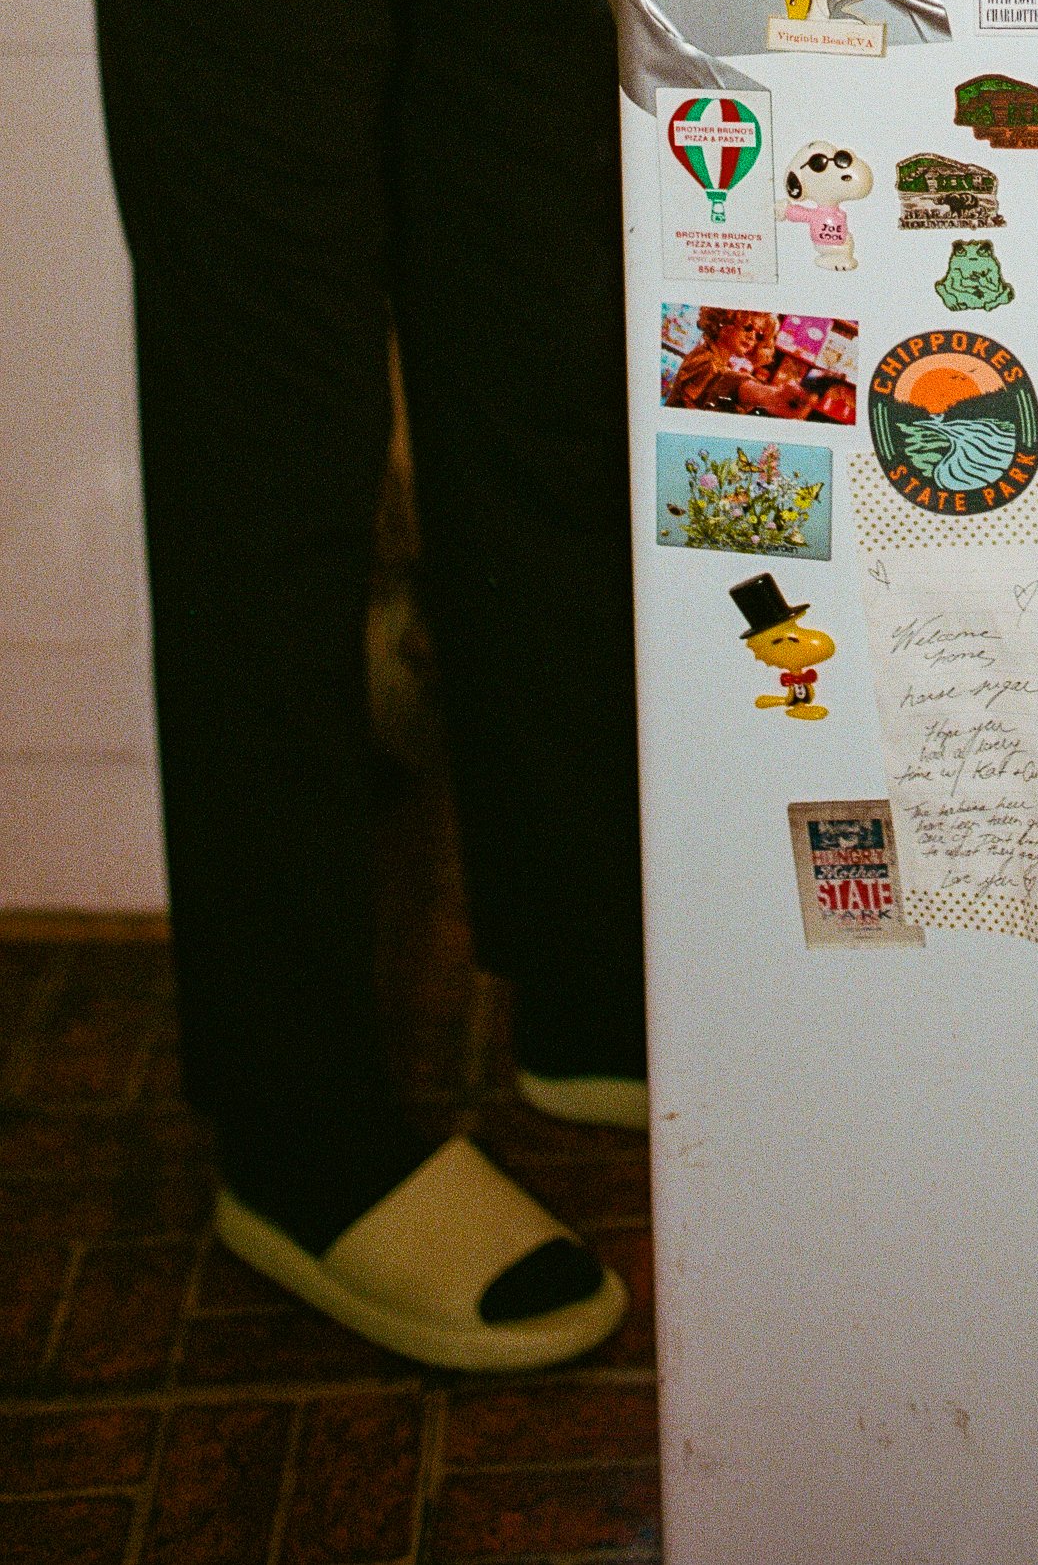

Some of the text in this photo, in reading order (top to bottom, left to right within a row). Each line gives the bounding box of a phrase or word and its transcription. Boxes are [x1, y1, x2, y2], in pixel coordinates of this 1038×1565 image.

[778, 31, 819, 44] Virginia
[675, 125, 754, 136] BROTHER BRUNO'S
[684, 134, 708, 143] PIZZA
[718, 135, 745, 144] PASTA
[821, 223, 842, 233] JOE
[675, 231, 762, 242] BROTHER BRUNO'S
[819, 233, 843, 241] COOL
[686, 240, 711, 249] PIZZA
[722, 241, 753, 251] PASTA
[698, 265, 742, 275] 856-4361
[873, 332, 1024, 395] CHIPPOKES
[889, 452, 1038, 513] STATE PARK
[817, 879, 894, 910] STATE
[822, 909, 892, 920] PARK
